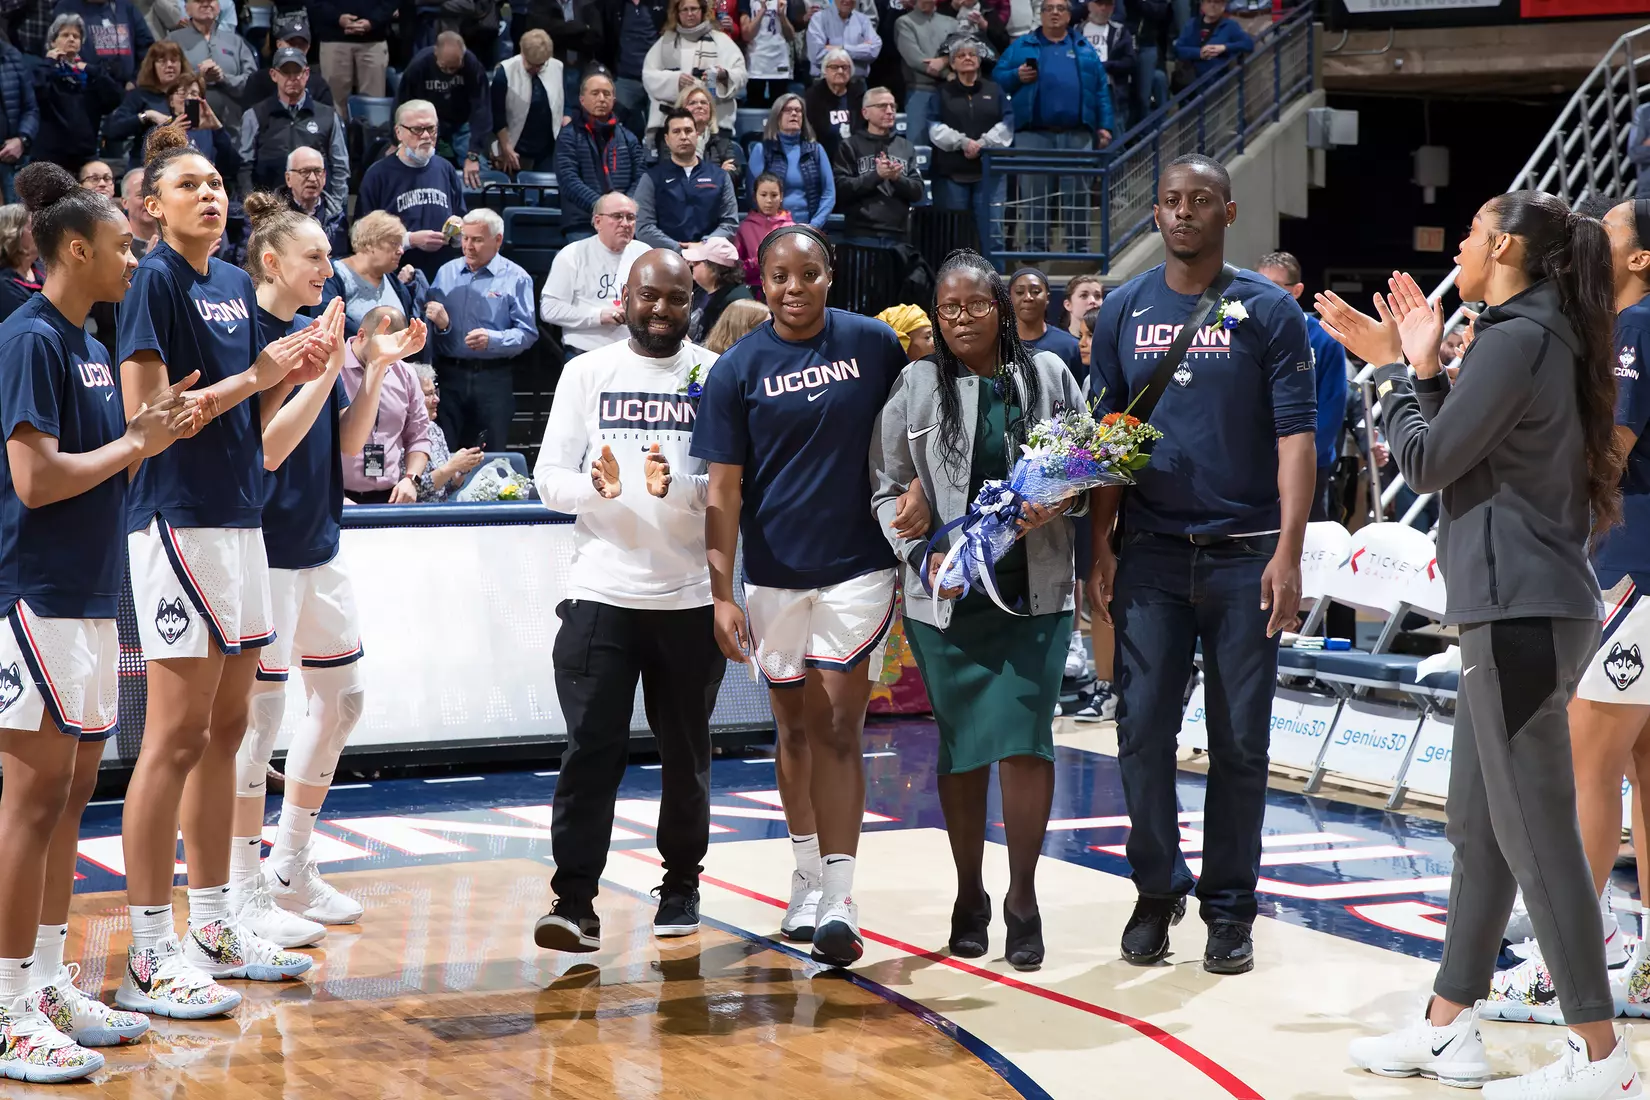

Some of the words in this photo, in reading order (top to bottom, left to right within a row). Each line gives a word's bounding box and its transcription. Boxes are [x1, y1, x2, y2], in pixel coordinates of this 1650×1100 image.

[396, 187, 449, 213] CONNECTICUT
[194, 297, 250, 322] UCONN
[763, 358, 860, 398] UCONN
[1613, 366, 1640, 381] CONN
[601, 433, 693, 443] BASKETBAL
[1269, 714, 1327, 738] genius3D
[1334, 727, 1407, 752] genius3D
